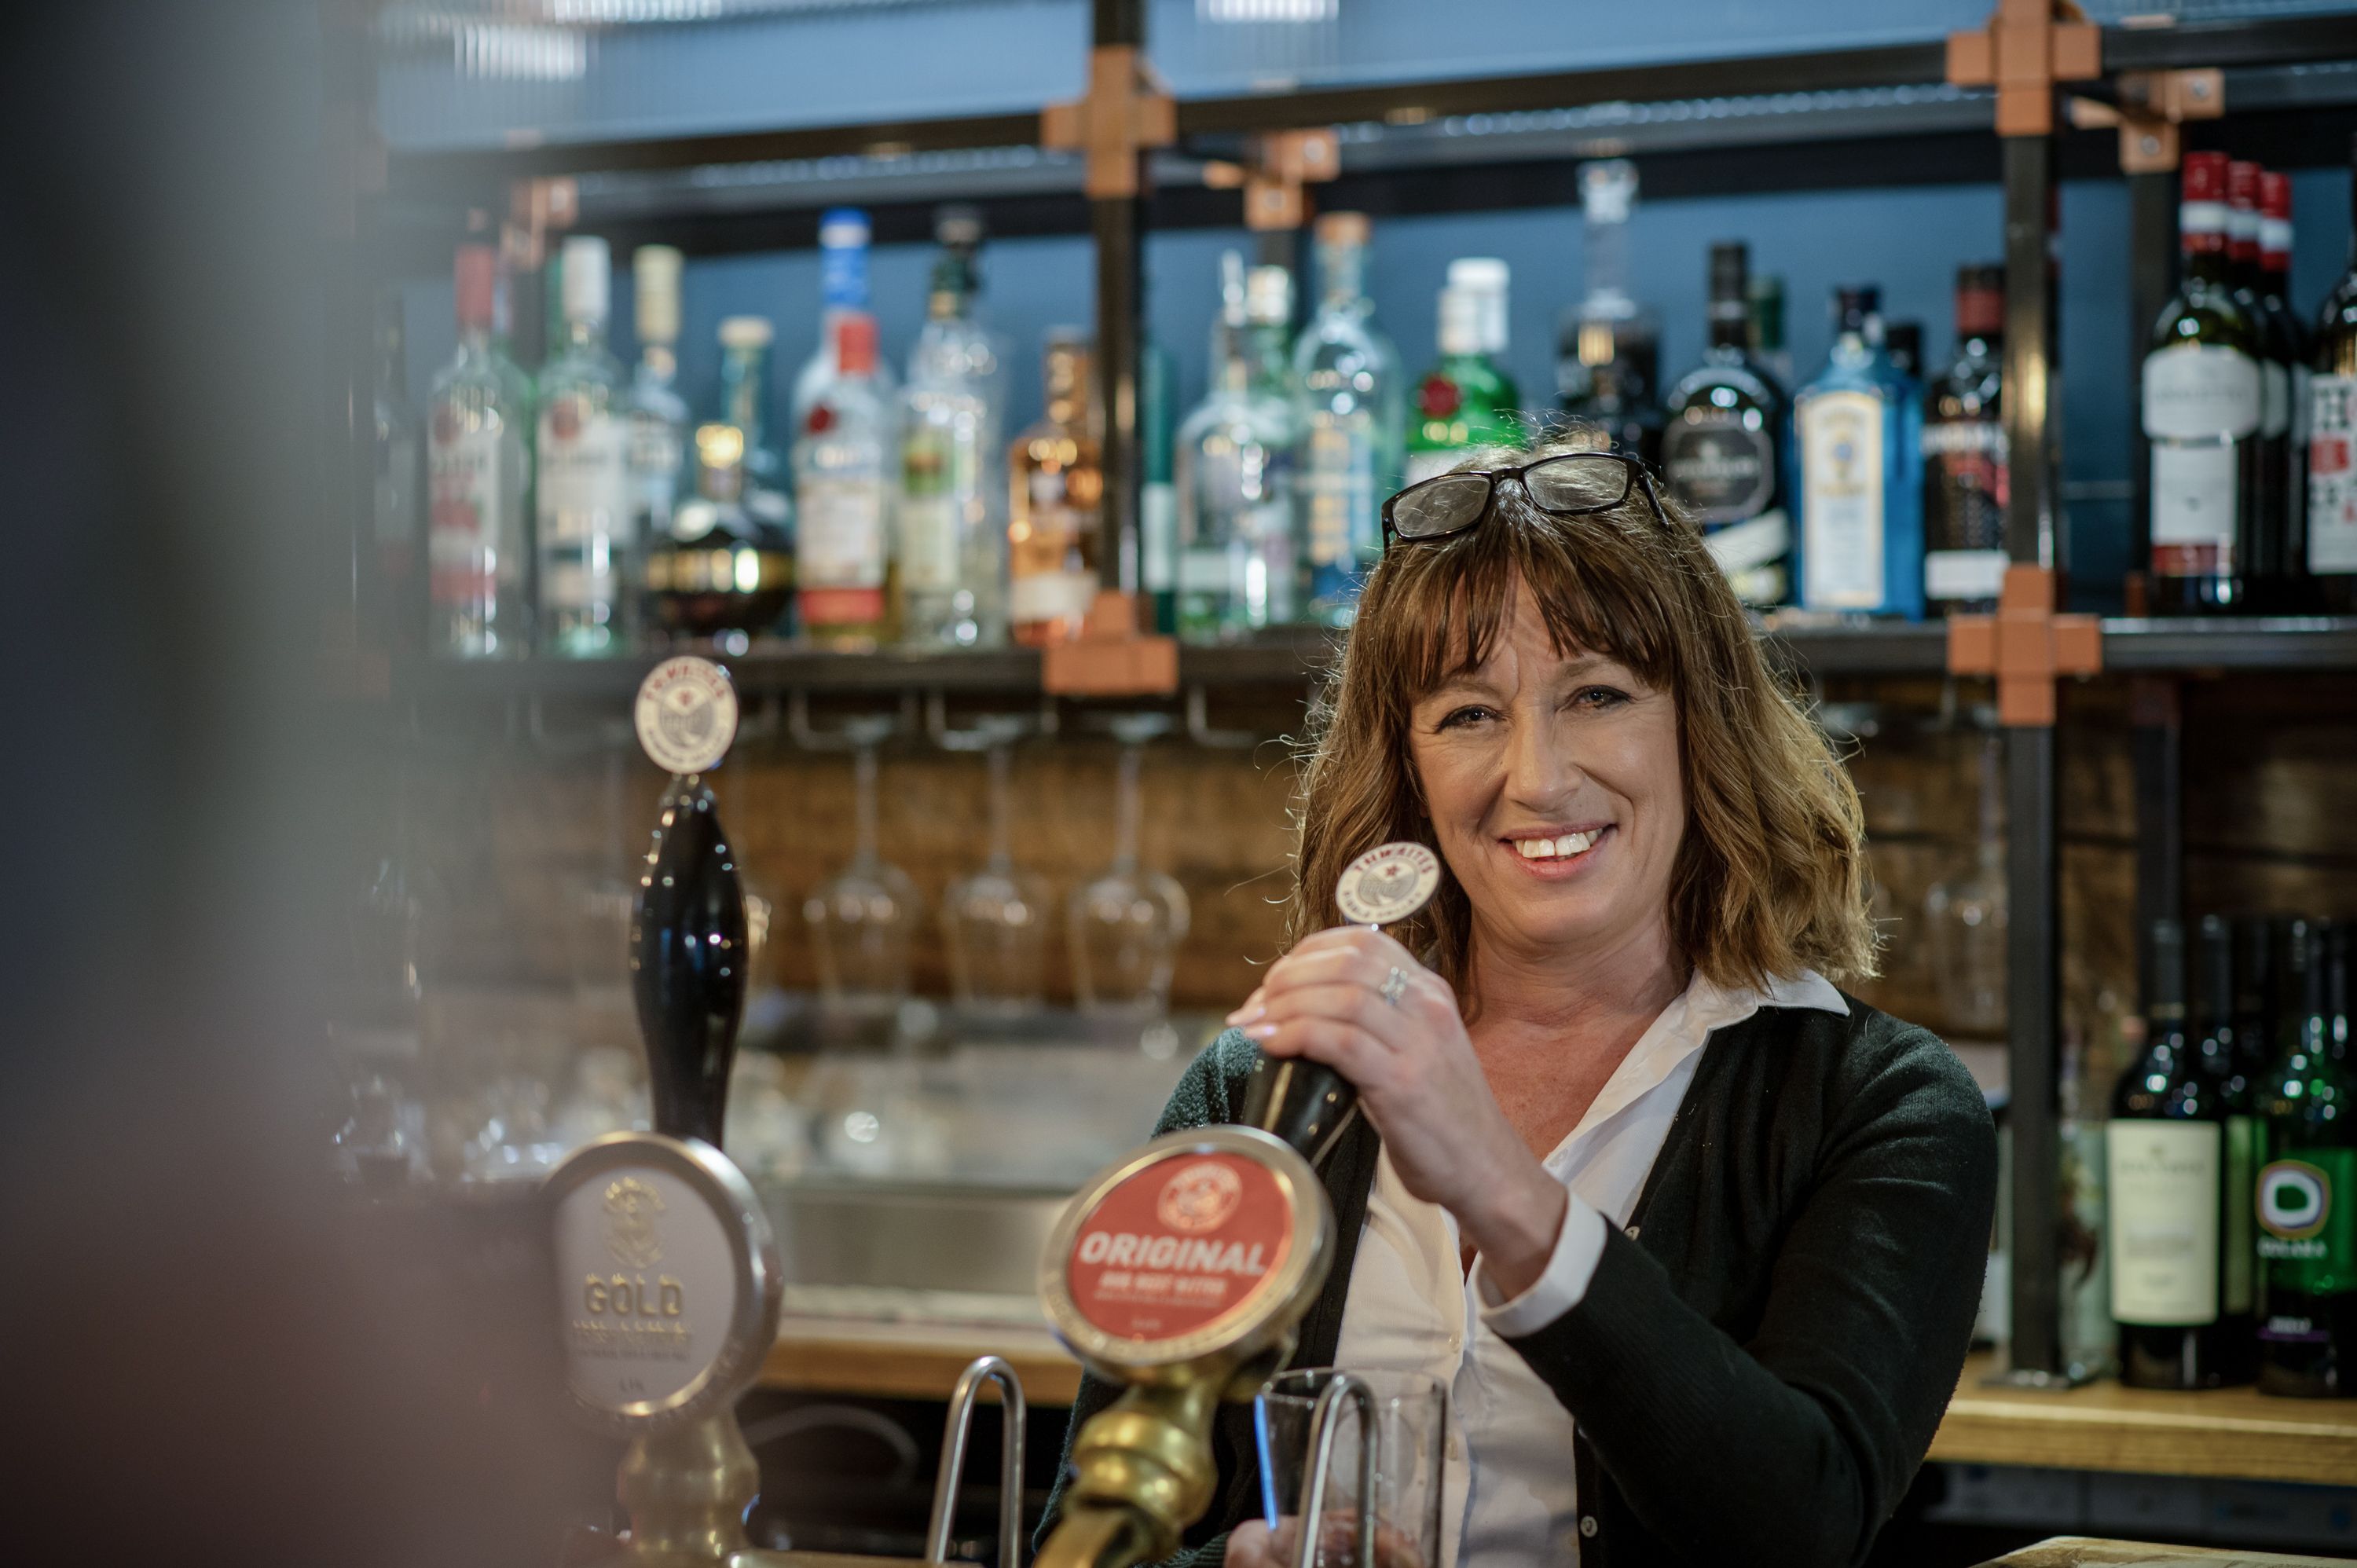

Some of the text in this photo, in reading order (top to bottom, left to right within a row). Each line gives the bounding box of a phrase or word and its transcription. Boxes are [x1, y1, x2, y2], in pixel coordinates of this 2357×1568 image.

[1354, 847, 1434, 874] THWAITES
[1080, 1231, 1266, 1276] ORIGINAL
[585, 1273, 683, 1315] GOLD
